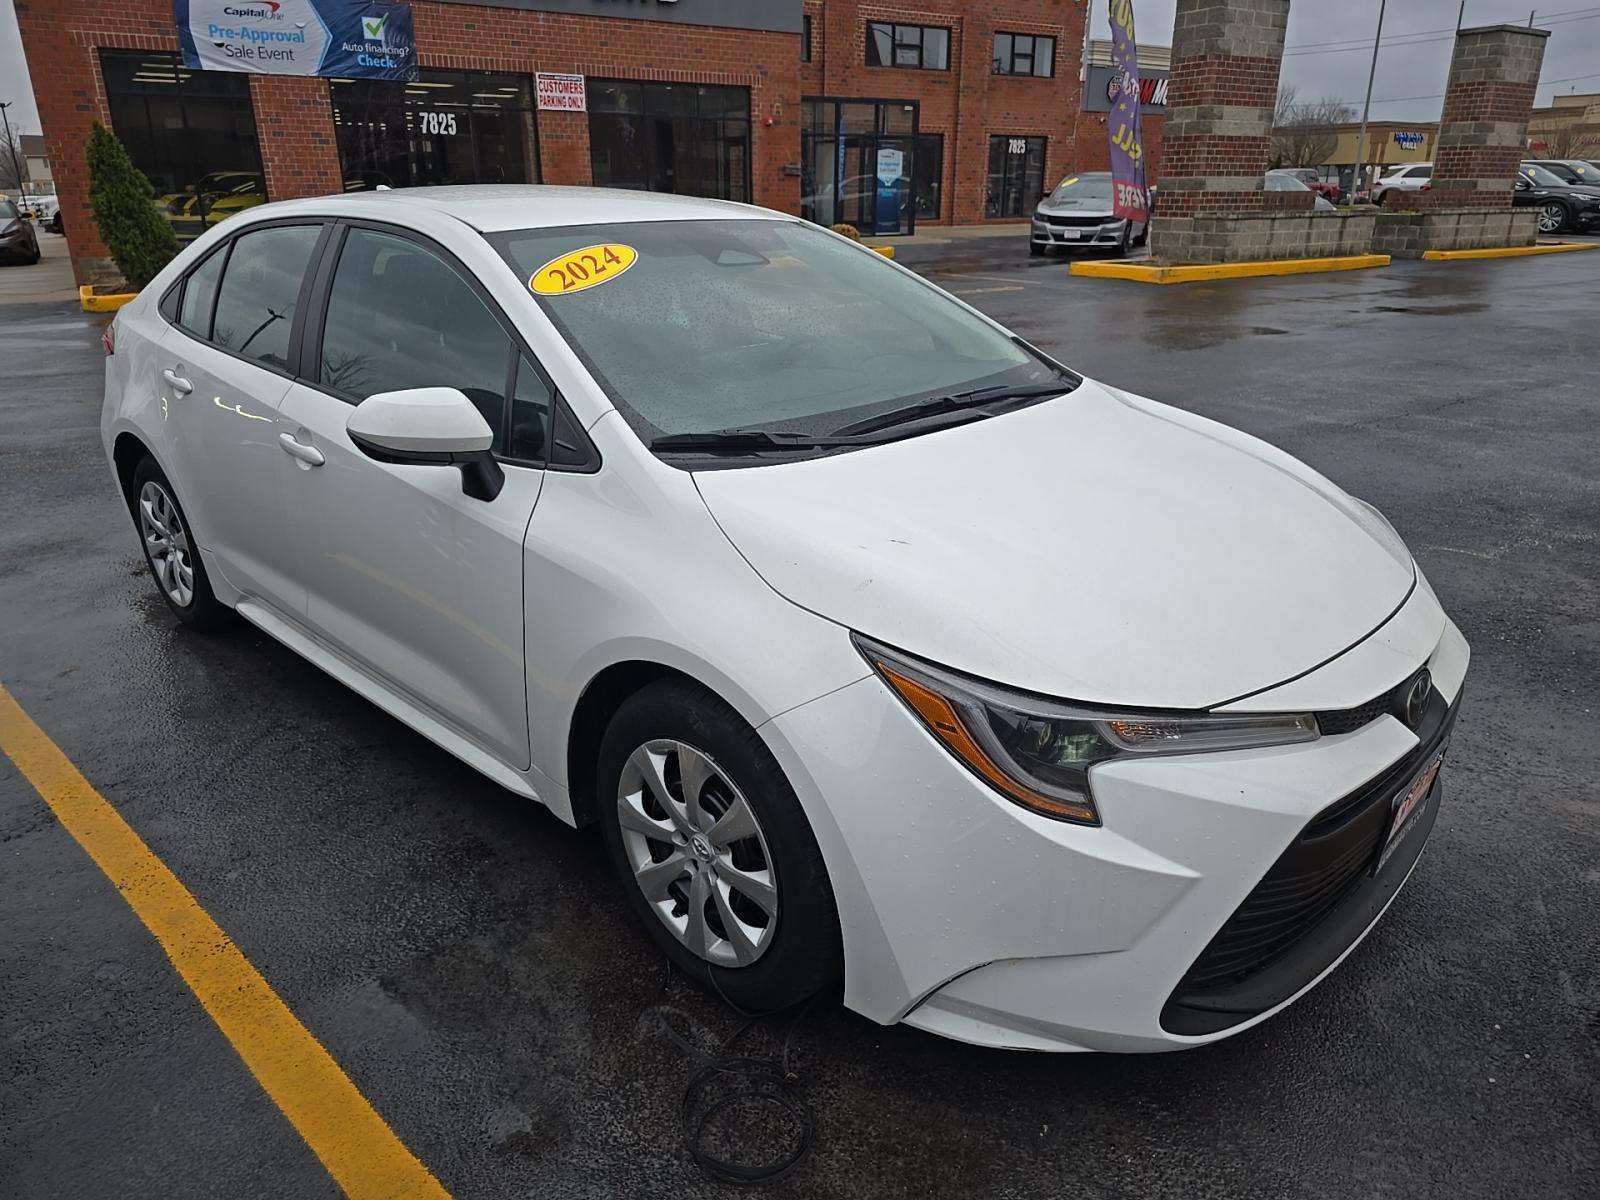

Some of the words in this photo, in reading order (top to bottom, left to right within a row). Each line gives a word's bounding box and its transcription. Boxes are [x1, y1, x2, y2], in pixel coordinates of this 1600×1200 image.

[208, 24, 305, 43] Pre-Approval
[225, 44, 254, 58] Sale
[258, 46, 295, 61] Event
[342, 42, 363, 52] Auto
[538, 80, 584, 94] CUSTOMERS
[539, 95, 567, 108] PARKING
[568, 96, 584, 108] ONLY
[419, 111, 457, 136] 7825
[549, 246, 621, 290] 2024
